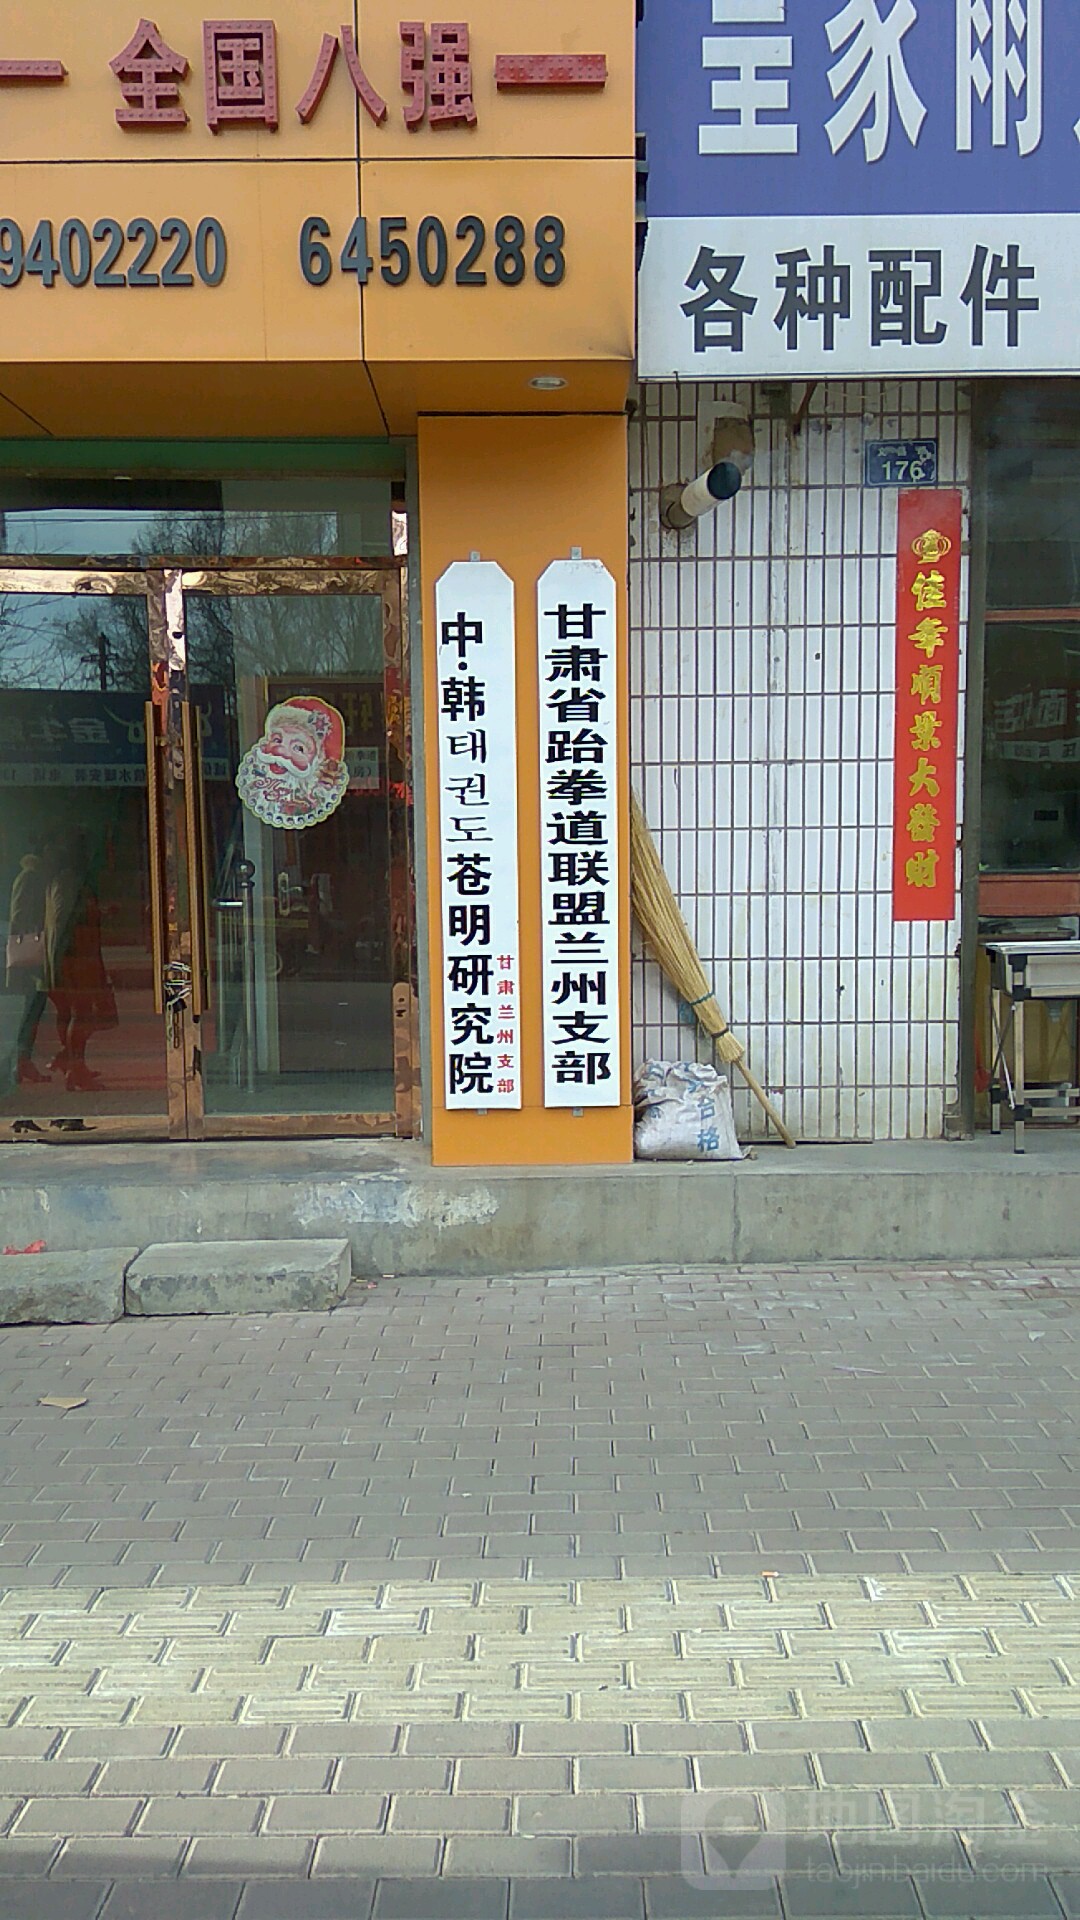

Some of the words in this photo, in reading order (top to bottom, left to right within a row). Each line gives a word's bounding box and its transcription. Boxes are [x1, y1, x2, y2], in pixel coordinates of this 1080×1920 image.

[300, 215, 566, 288] 6450288
[679, 244, 1040, 353] 各种配件
[543, 603, 612, 1085] 甘肃省跆拳道联盟兰州支部
[496, 955, 514, 1093] 甘肃兰州支部
